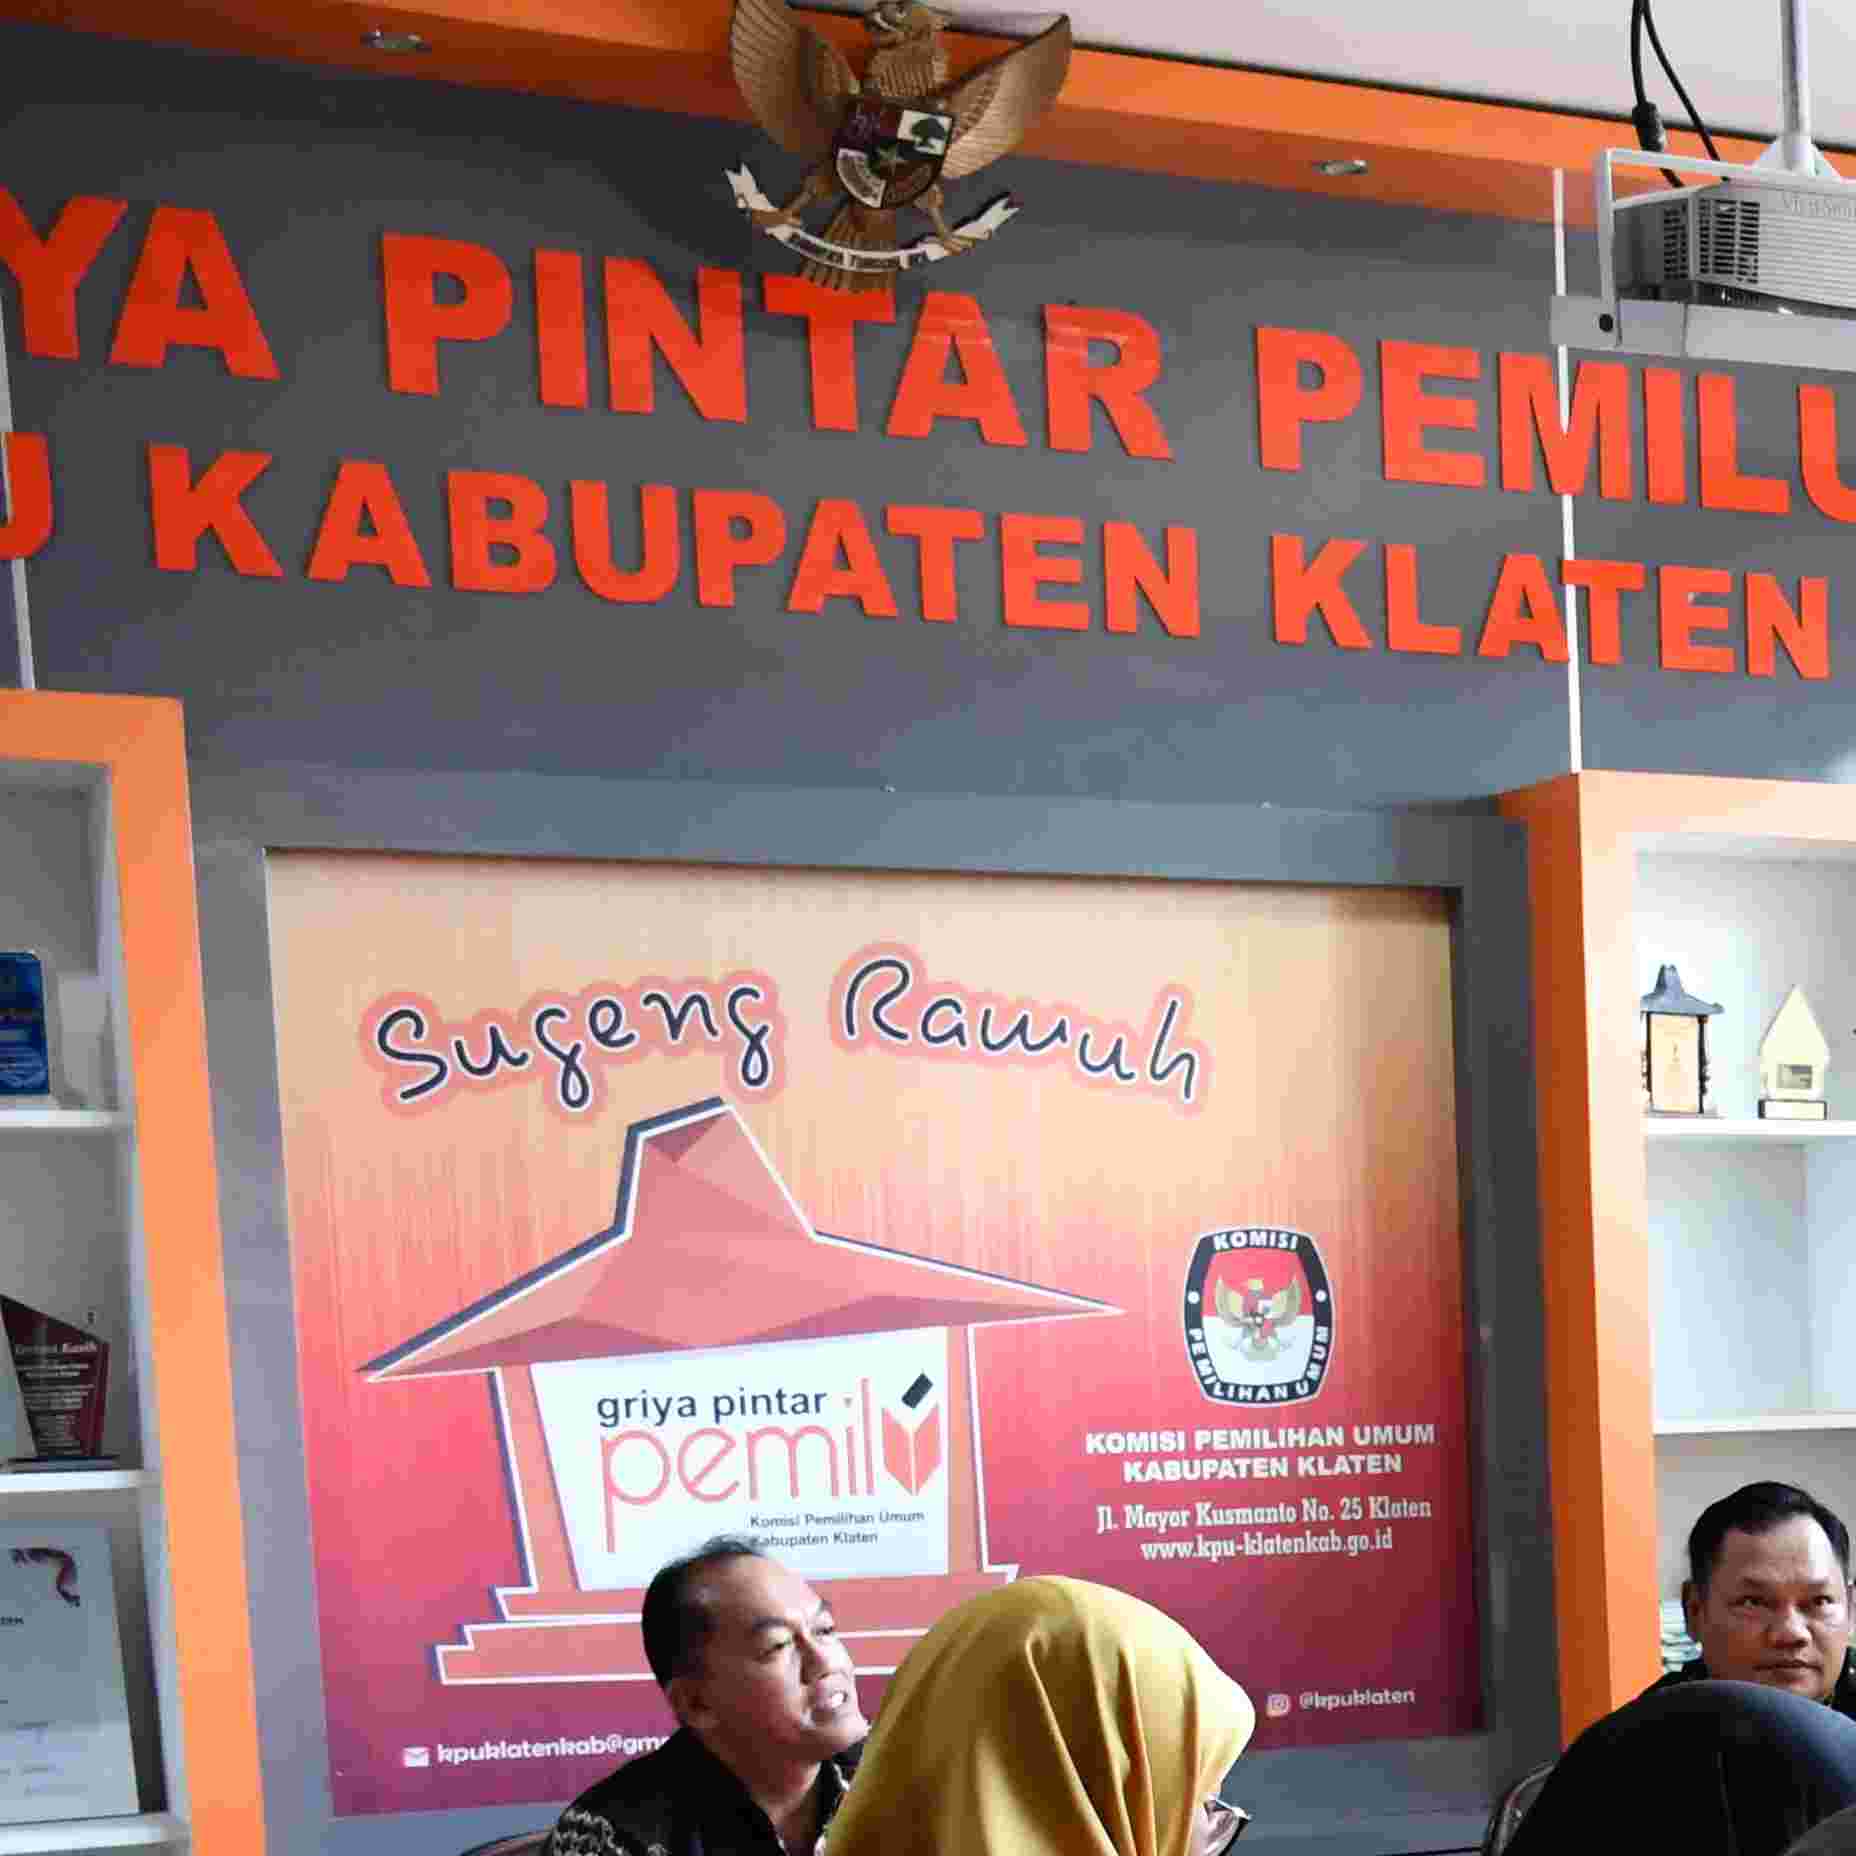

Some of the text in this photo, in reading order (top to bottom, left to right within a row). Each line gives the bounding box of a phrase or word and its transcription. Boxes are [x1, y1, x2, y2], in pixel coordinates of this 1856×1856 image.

[381, 231, 1174, 462] PINTAR
[147, 443, 1200, 640] KABUPATEN
[1270, 532, 1831, 681] KLATEN
[376, 956, 1200, 1110] Sugeng Rawuh
[1214, 1231, 1298, 1251] KOMISI
[1189, 1326, 1329, 1401] PEMILIHAN UMUM
[597, 1386, 827, 1428] griya pintar
[1086, 1424, 1435, 1454] KOMISI PEMILIHAN UMUM
[1123, 1454, 1402, 1483] KABUPATEN KLATEN
[750, 1509, 925, 1529] Komisi Pemilihan Umum
[1124, 1504, 1190, 1533] Mayor
[1195, 1501, 1297, 1528] Kusmanto
[1301, 1498, 1335, 1523] No.
[1340, 1497, 1362, 1520] 25
[1369, 1495, 1432, 1521] Klaten
[833, 1531, 878, 1546] Klaten
[1140, 1527, 1393, 1563] www.kpu-klatenkab.go.id
[1300, 1688, 1416, 1712] @kpuklaten
